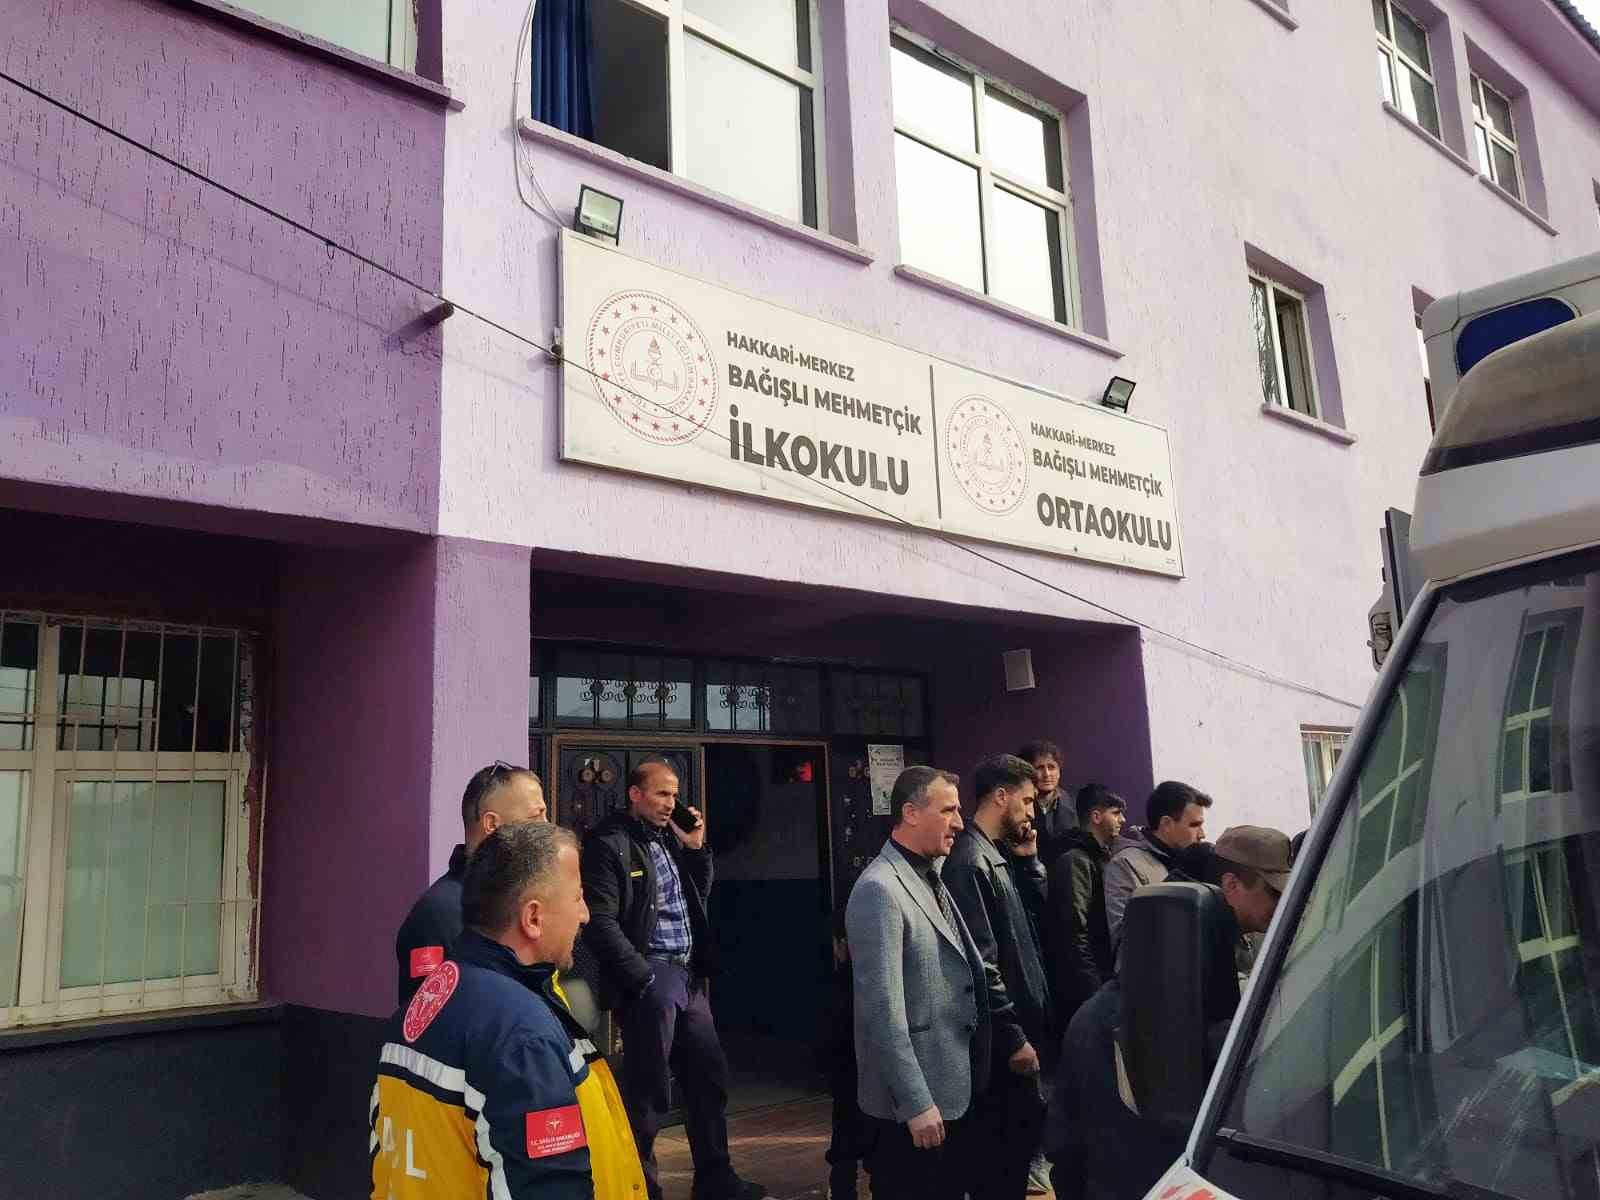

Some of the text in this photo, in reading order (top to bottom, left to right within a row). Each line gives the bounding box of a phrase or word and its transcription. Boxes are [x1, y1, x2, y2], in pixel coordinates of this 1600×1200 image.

[727, 331, 855, 382] HAKKARİ-MERKEZ
[728, 364, 808, 407] BAĞIŞLI
[814, 388, 921, 436] MEHMETÇİK
[729, 404, 909, 495] İLKOKULU
[1030, 422, 1116, 457] HAKKARİ-MERKEZ
[1033, 448, 1086, 480] BAĞIŞLI
[1089, 464, 1163, 498] MEHMETÇİK
[1037, 492, 1171, 551] ORTAOKULU
